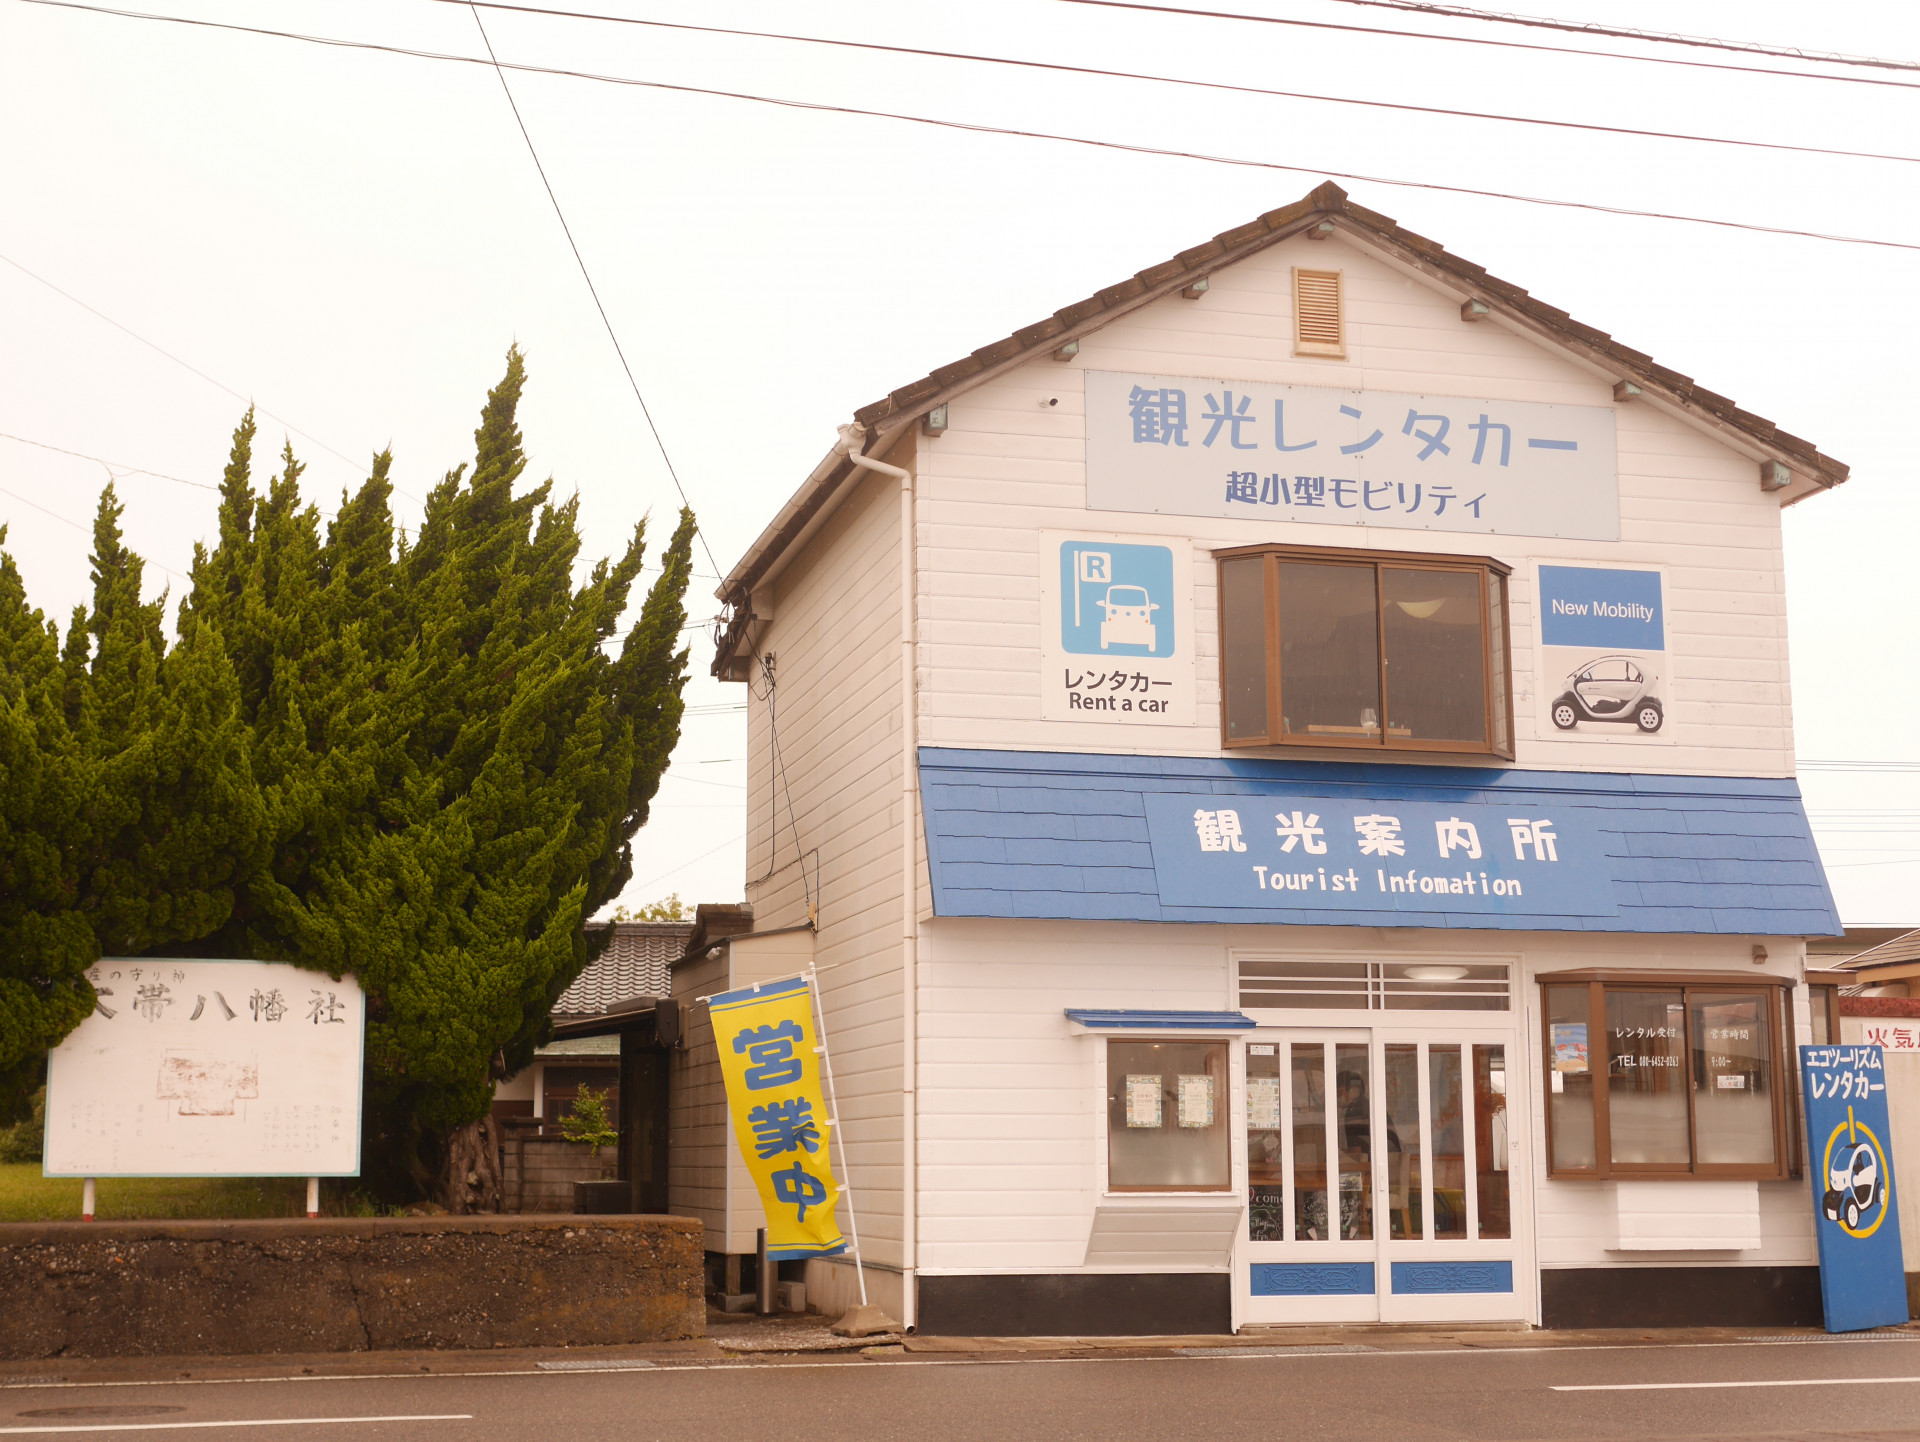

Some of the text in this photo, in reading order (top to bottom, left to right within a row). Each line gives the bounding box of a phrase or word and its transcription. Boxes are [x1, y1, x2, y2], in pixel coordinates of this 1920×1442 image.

[1128, 384, 1578, 467] 観光レンタカー
[1225, 470, 1487, 519] 超小型モビリティ
[1086, 555, 1106, 579] R
[1552, 599, 1654, 623] New Mobility
[1065, 668, 1173, 693] レンタカー
[1069, 691, 1169, 713] Rent a car
[1193, 808, 1559, 862] 観光案内所
[1253, 866, 1523, 896] Tourist Infomation
[1616, 1027, 1677, 1039] レンタル受付
[1710, 1029, 1749, 1041] 営業時間
[1866, 1027, 1920, 1049] 火気
[1617, 1055, 1637, 1067] TEL
[1806, 1046, 1882, 1071] エコツーリズム
[1811, 1070, 1885, 1100] レンタカー
[732, 1019, 828, 1223] 営業中
